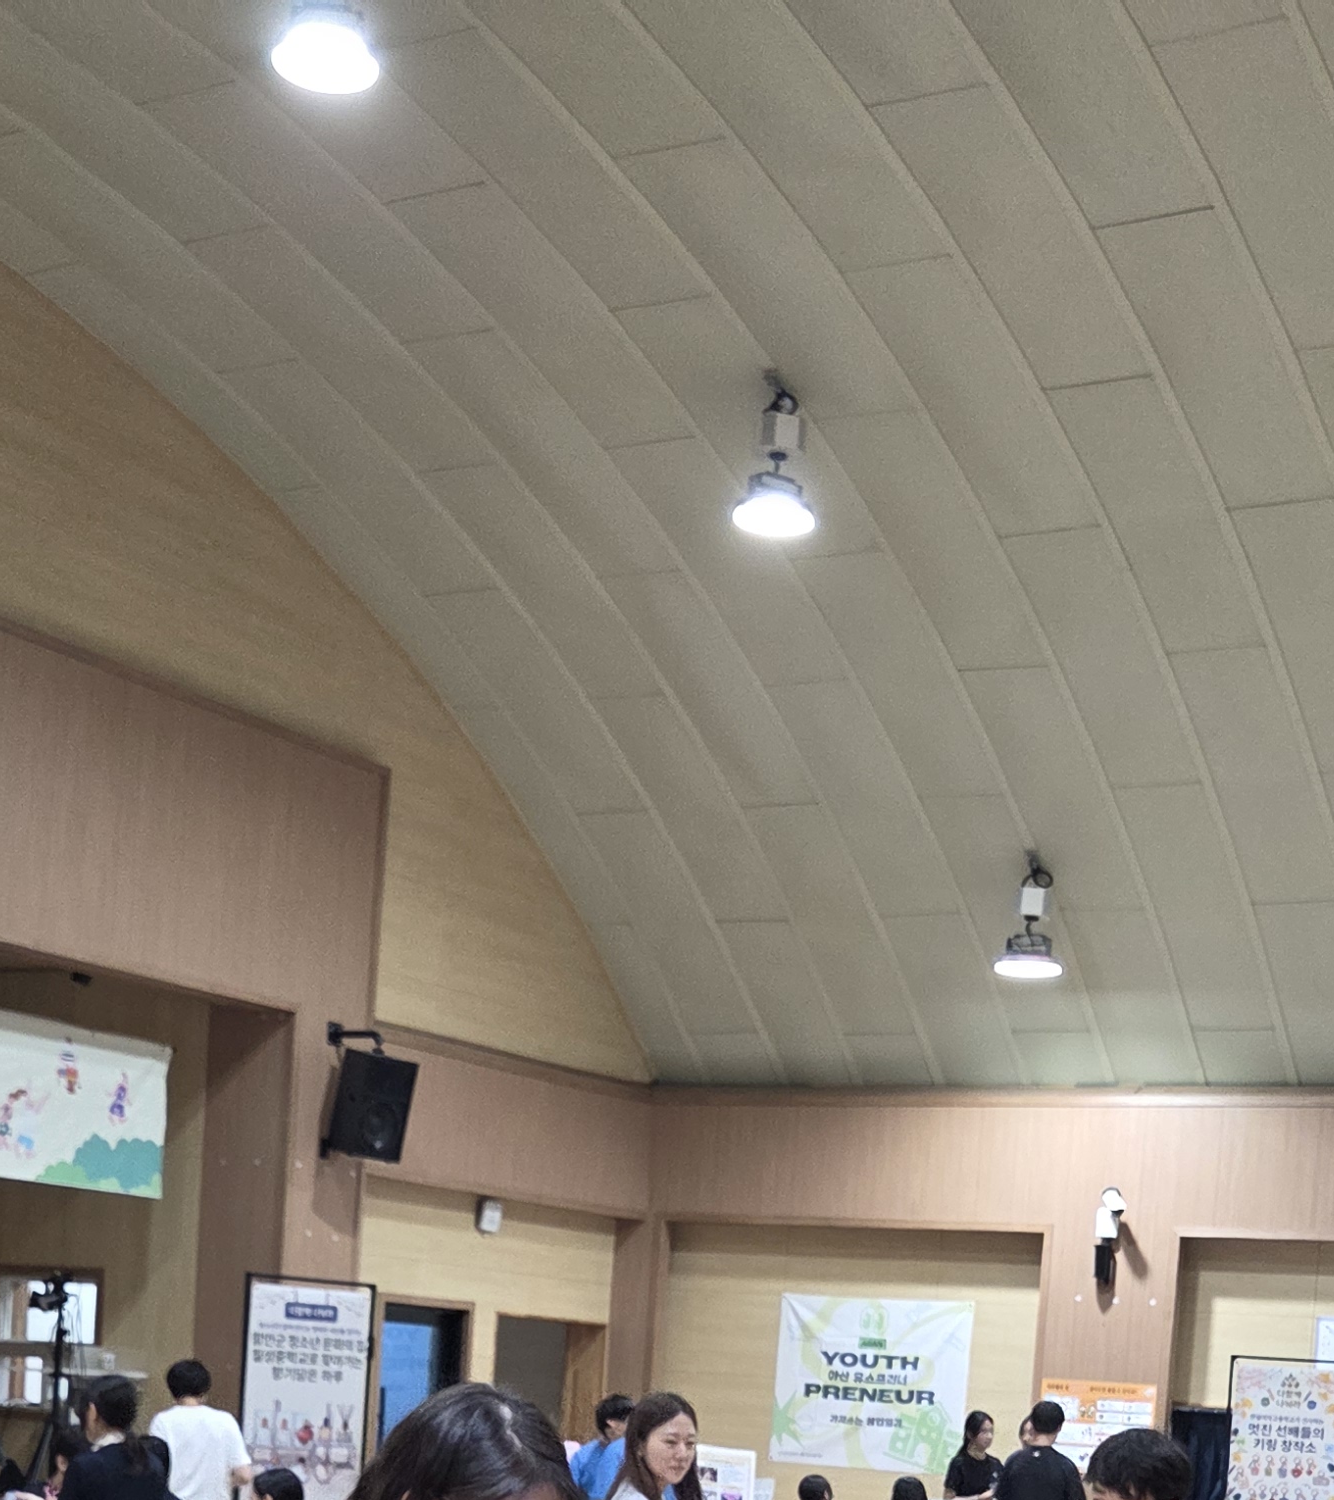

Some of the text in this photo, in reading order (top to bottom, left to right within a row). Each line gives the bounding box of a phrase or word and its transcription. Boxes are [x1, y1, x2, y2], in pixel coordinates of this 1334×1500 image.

[821, 1351, 919, 1371] YOUTH
[828, 1370, 849, 1382] 아산
[804, 1383, 935, 1405] PRENEUR
[1248, 1423, 1325, 1441] 멋진 선배들의
[1253, 1438, 1316, 1453] 키링 창작소
